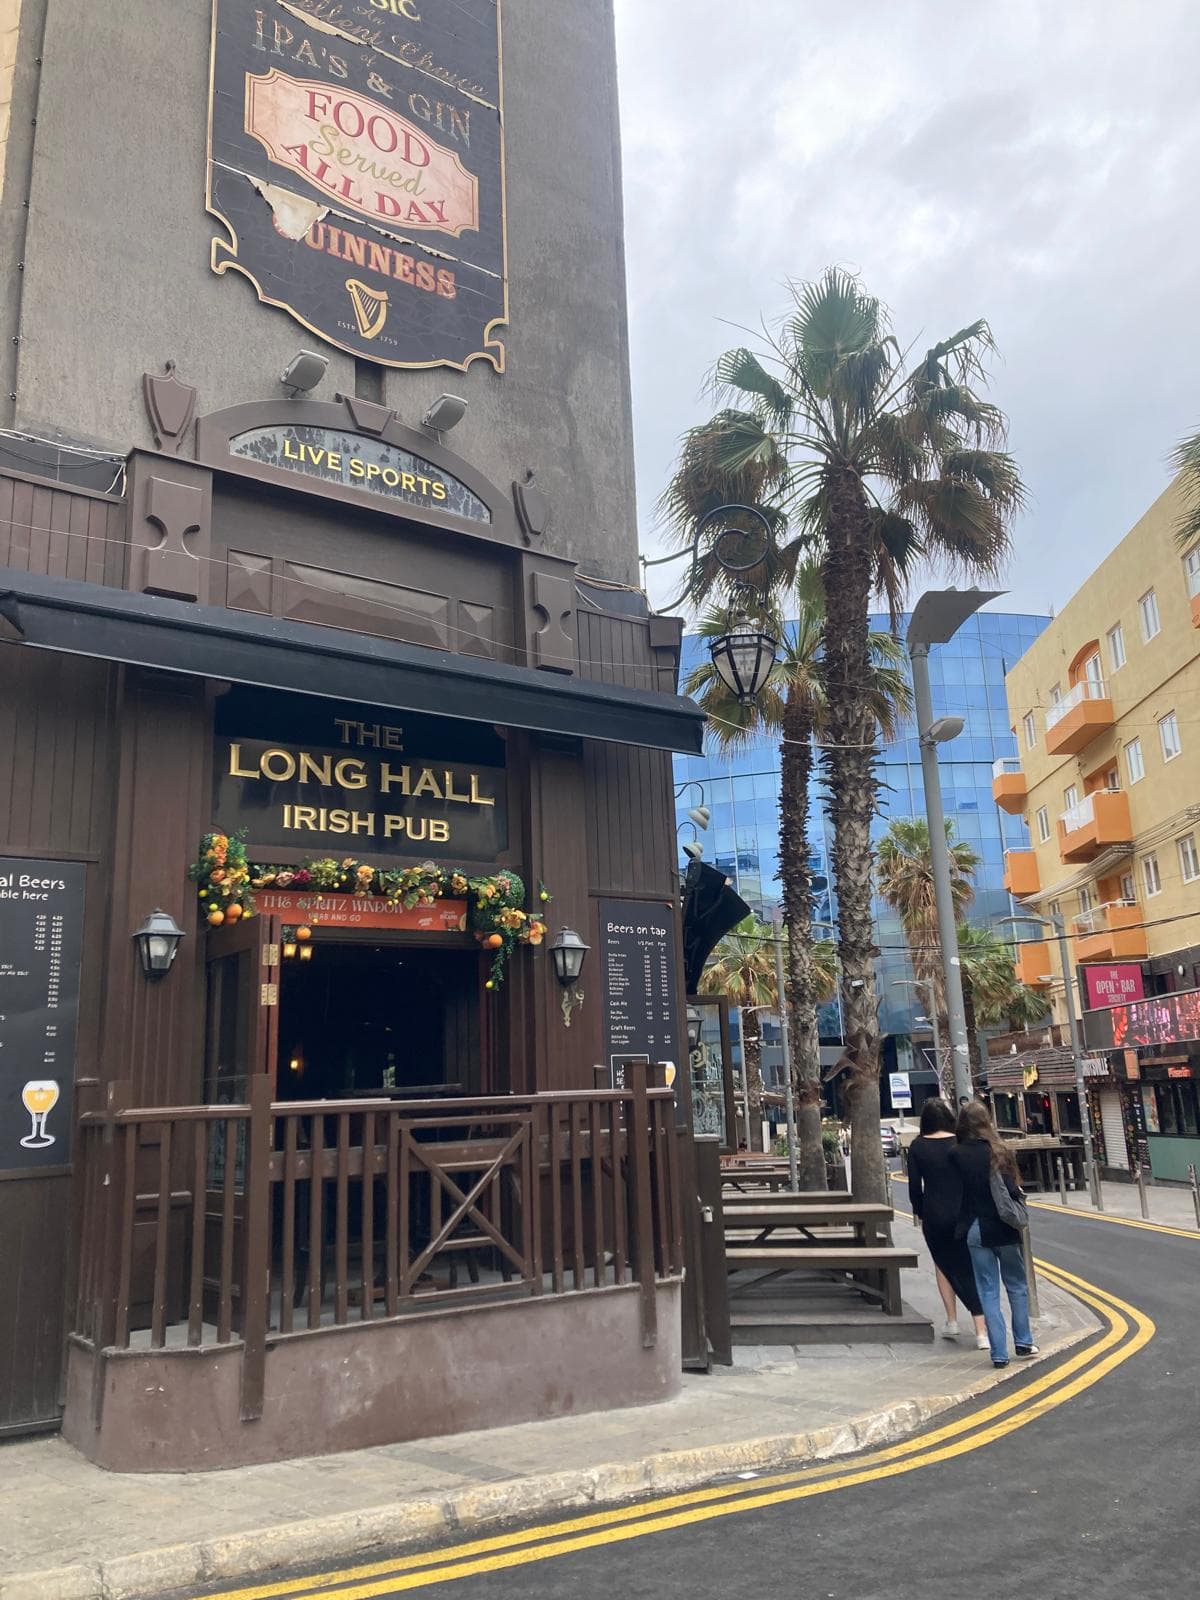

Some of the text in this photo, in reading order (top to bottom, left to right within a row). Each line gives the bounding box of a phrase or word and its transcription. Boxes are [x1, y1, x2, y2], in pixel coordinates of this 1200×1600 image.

[304, 89, 431, 168] FOOD
[366, 71, 393, 100] &
[408, 92, 470, 149] GIN
[280, 142, 450, 224] ALL DAY
[308, 124, 425, 196] Served
[290, 216, 457, 299] UINNESS
[283, 440, 446, 500] LIVE SPORTS
[334, 718, 403, 751] THE
[228, 743, 495, 806] LONG HALL
[282, 804, 450, 842] IRISH PUB
[19, 874, 66, 890] Beers
[22, 890, 49, 901] here
[331, 913, 347, 921] AND
[349, 914, 361, 922] GO
[607, 922, 667, 938] Beers on tap
[1096, 979, 1136, 994] OPEN BAR
